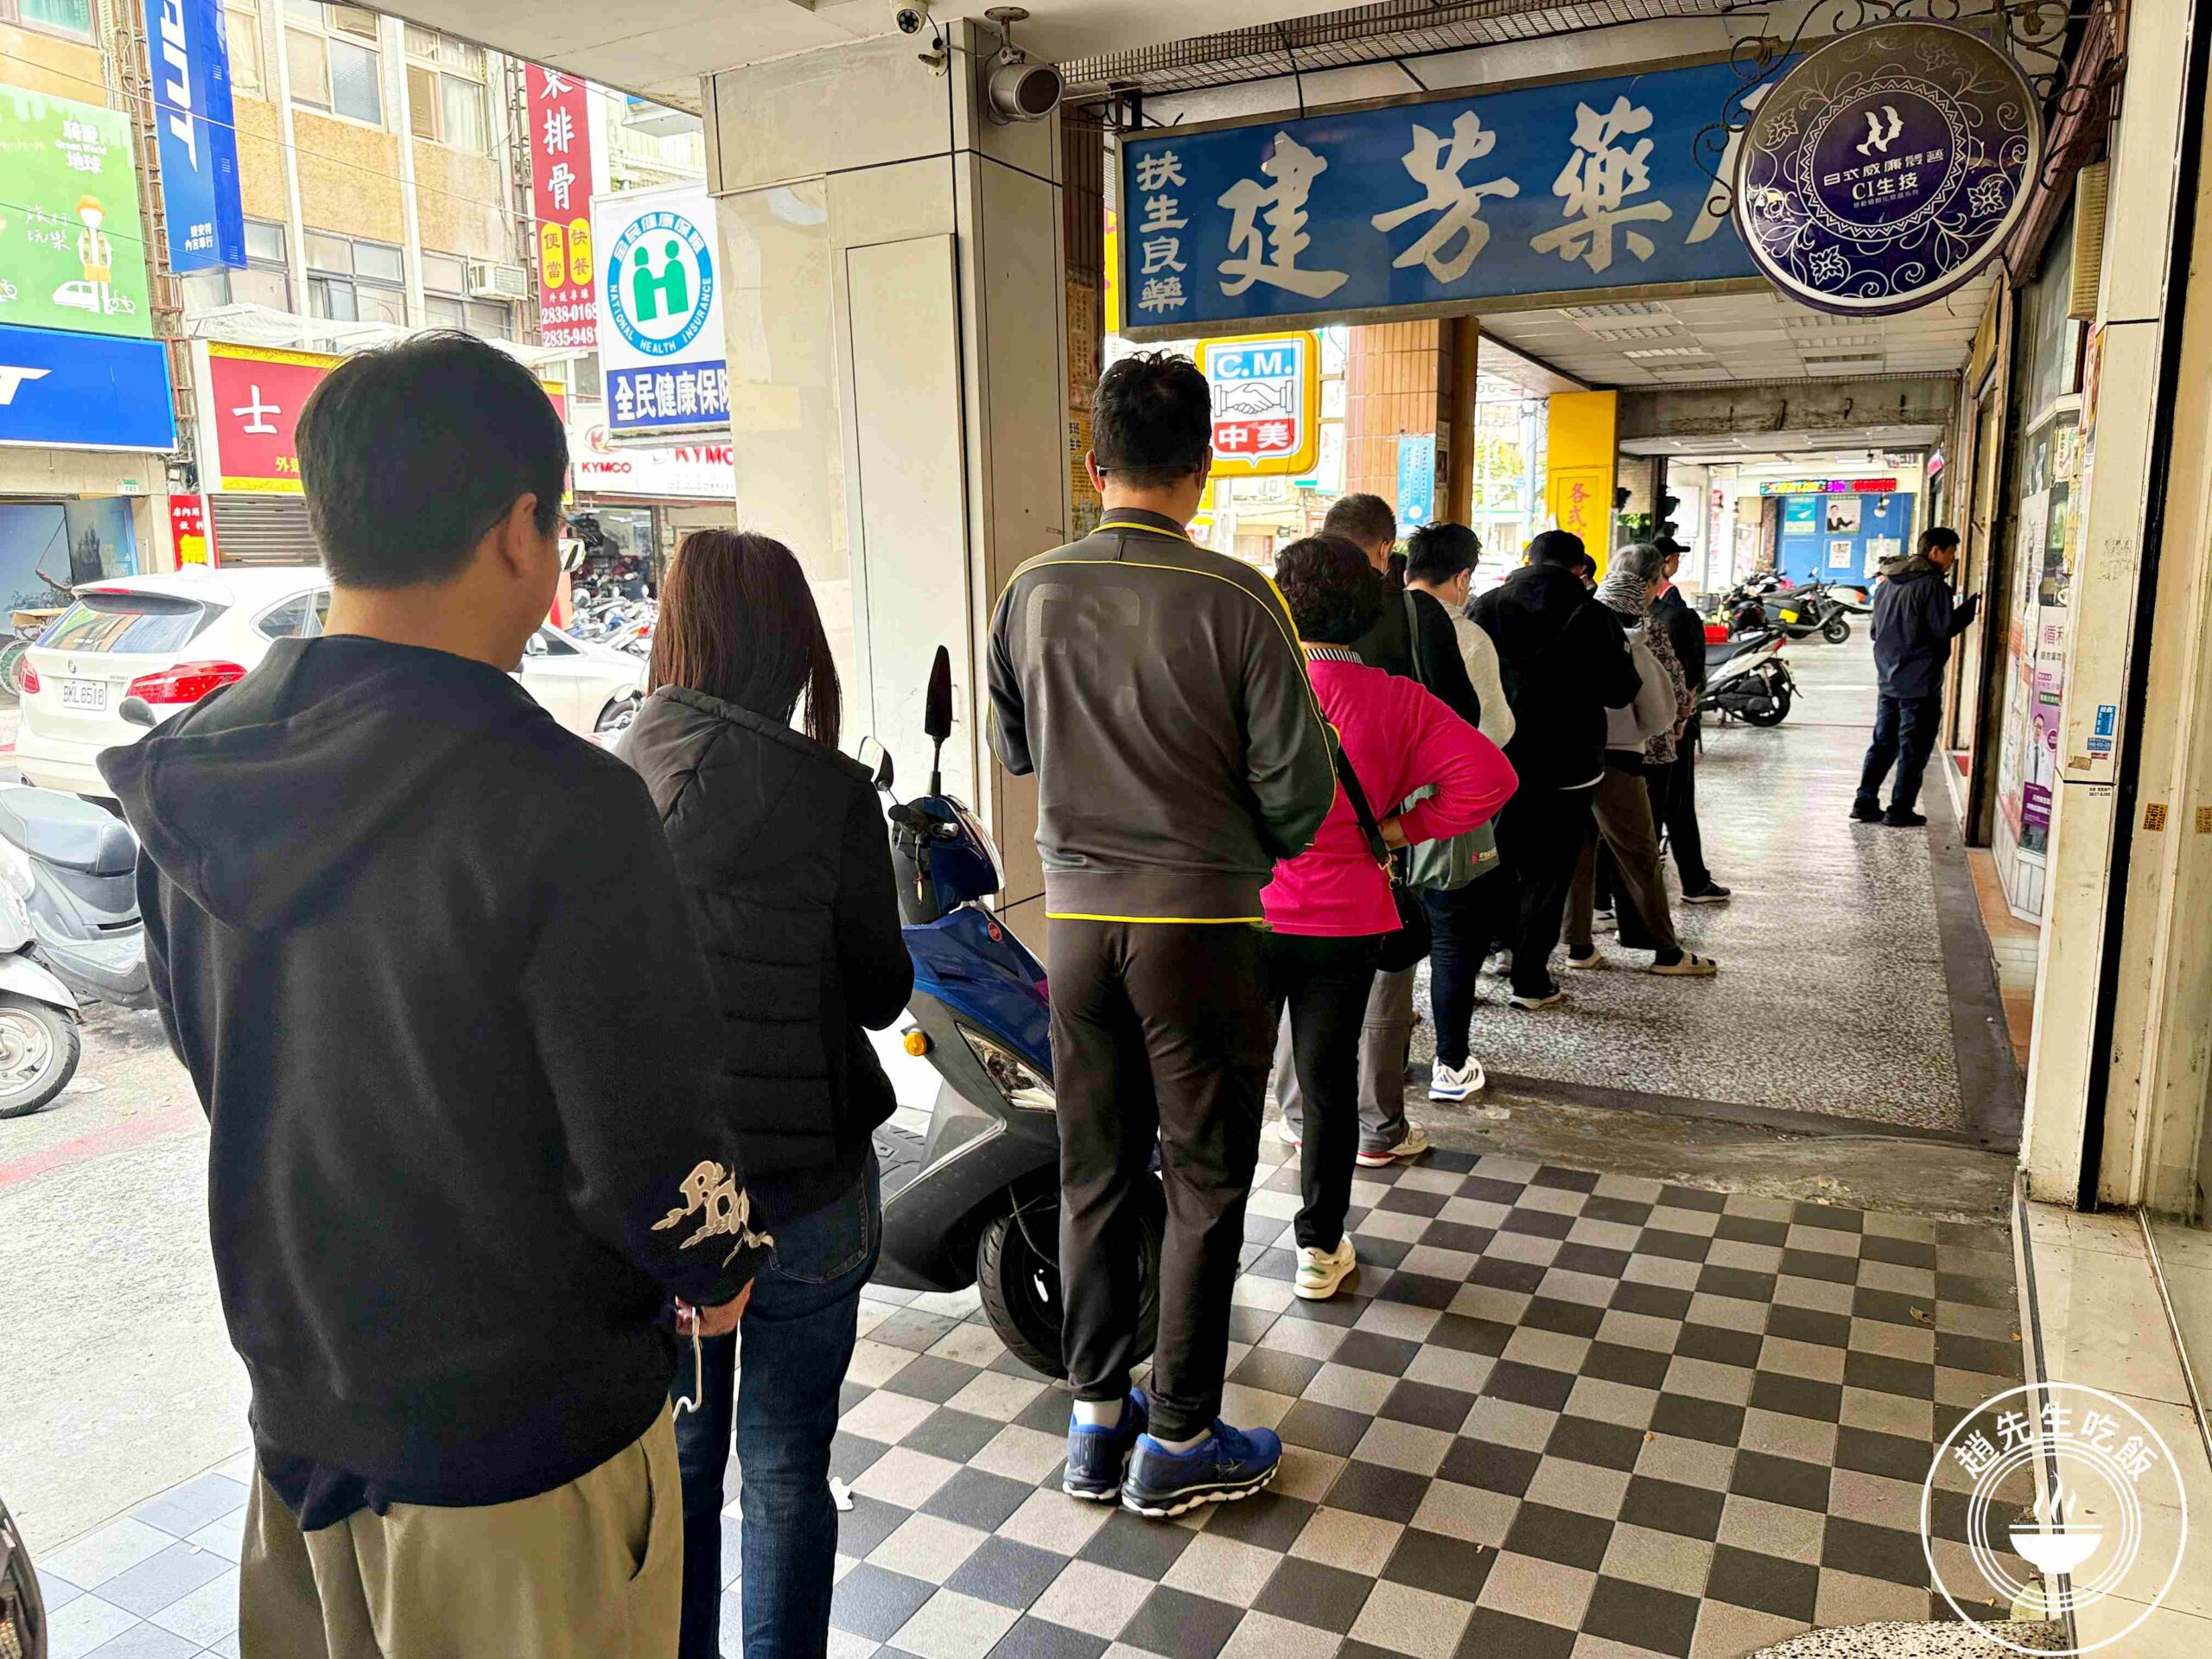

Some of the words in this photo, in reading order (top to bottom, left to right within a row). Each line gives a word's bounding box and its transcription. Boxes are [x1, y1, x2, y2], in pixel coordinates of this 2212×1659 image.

[1852, 172, 1918, 200] CI生技
[1135, 149, 1187, 314] 扶生良藥
[543, 232, 562, 279] 便當
[571, 229, 589, 276] 快餐
[542, 302, 597, 325] 2838-0168
[610, 283, 635, 340] NATIONAL
[640, 340, 676, 354] HEALTH
[682, 277, 711, 343] INSURANCE
[1217, 352, 1292, 378] C.M.
[232, 384, 282, 434] 士
[1218, 422, 1288, 450] 中美
[582, 461, 632, 474] KYMCO
